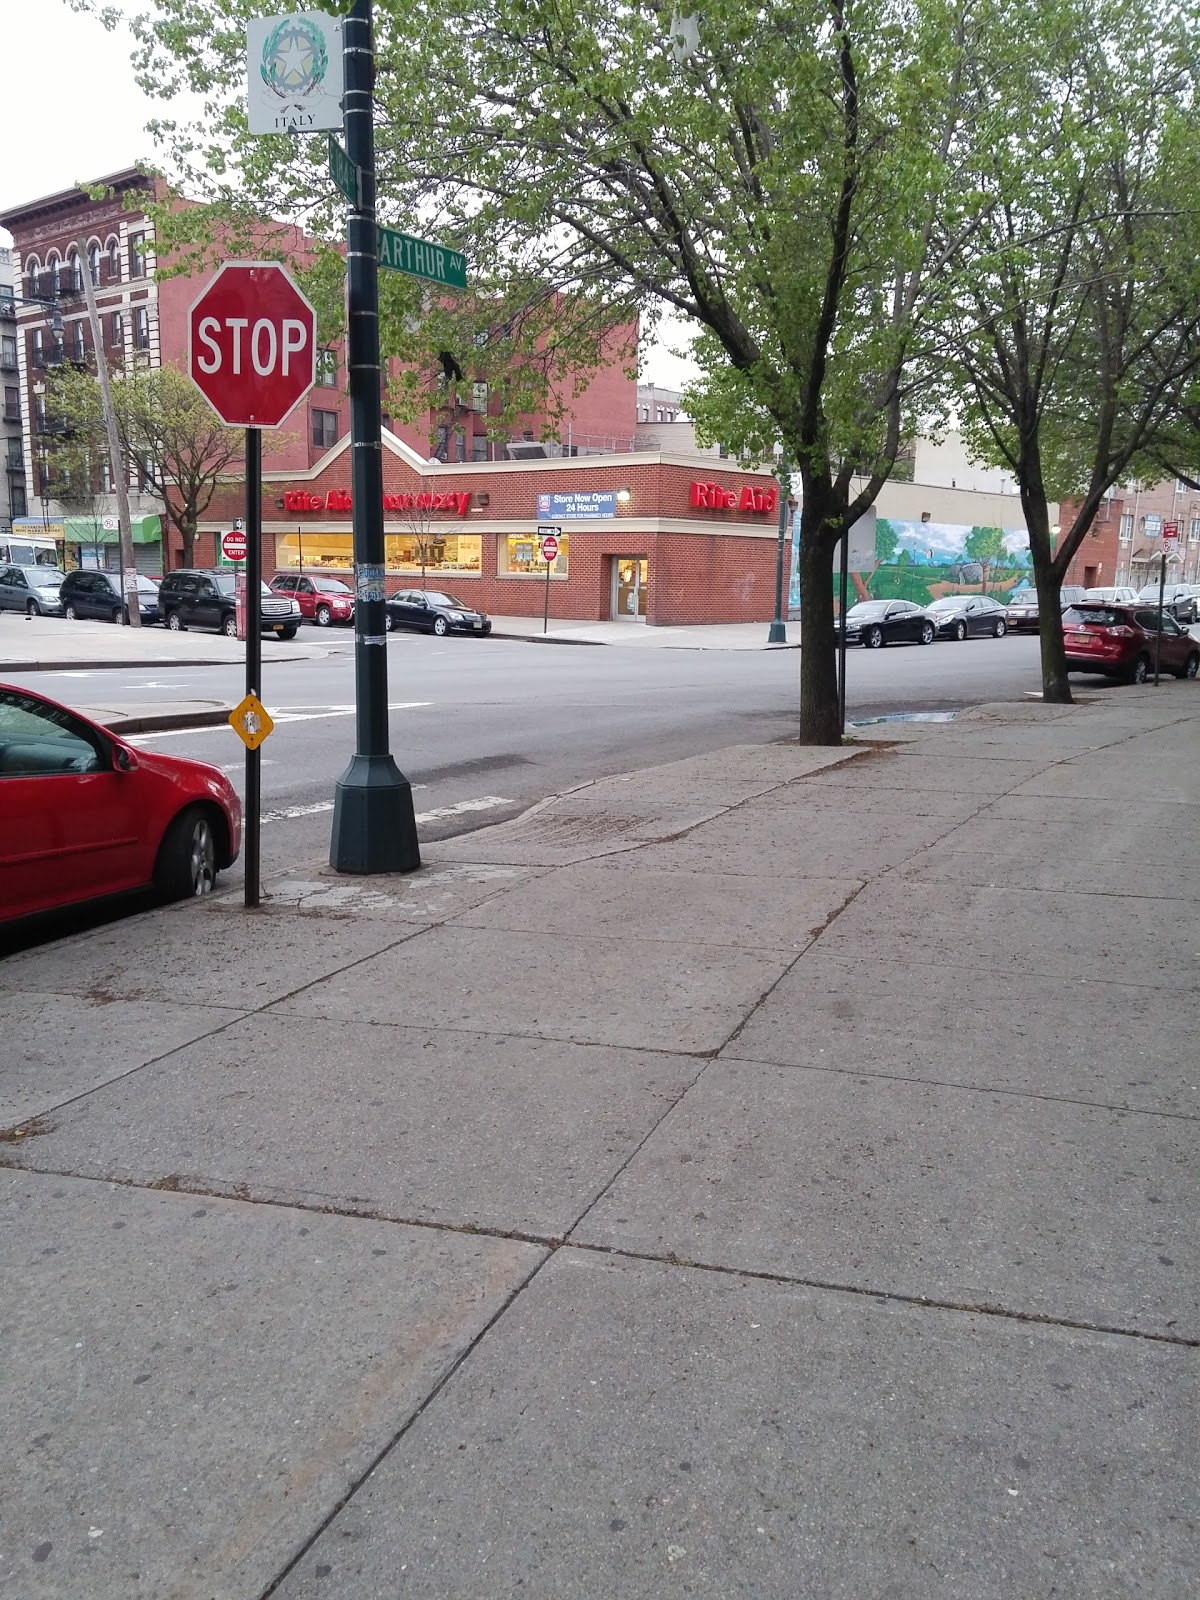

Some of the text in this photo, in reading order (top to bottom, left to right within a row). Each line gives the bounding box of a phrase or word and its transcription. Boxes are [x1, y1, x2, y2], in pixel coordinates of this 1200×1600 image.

[274, 113, 316, 128] ITALY
[380, 233, 462, 279] ARTHUR AV
[197, 316, 307, 377] STOP
[284, 489, 323, 511] Rite
[553, 493, 612, 503] Store Now Open
[566, 503, 599, 512] 24 Hours
[690, 481, 777, 512] Rite Aid
